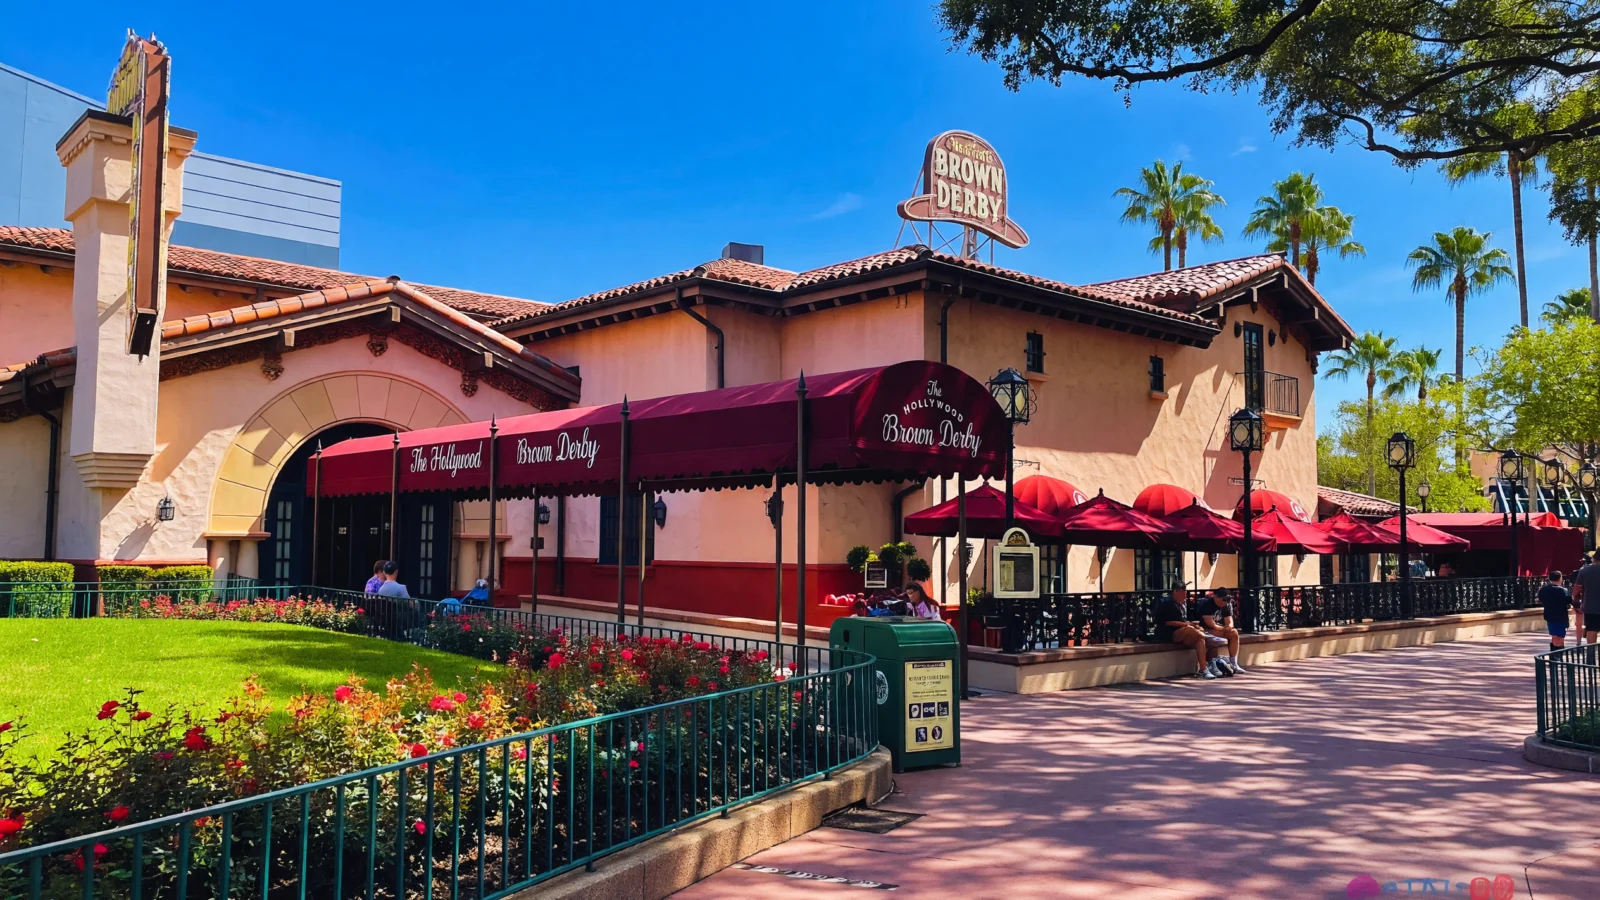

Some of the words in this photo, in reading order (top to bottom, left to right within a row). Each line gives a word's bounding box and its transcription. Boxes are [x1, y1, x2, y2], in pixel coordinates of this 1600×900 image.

[934, 147, 1003, 195] BROWN
[936, 179, 1003, 223] DERBY
[927, 380, 943, 397] The
[903, 398, 964, 422] HOLLYWOOD
[516, 437, 553, 465] Brown
[555, 427, 600, 469] Derby
[882, 413, 935, 447] Brown
[938, 419, 982, 458] Derby
[410, 448, 428, 473] The
[430, 440, 483, 478] Hollywood
